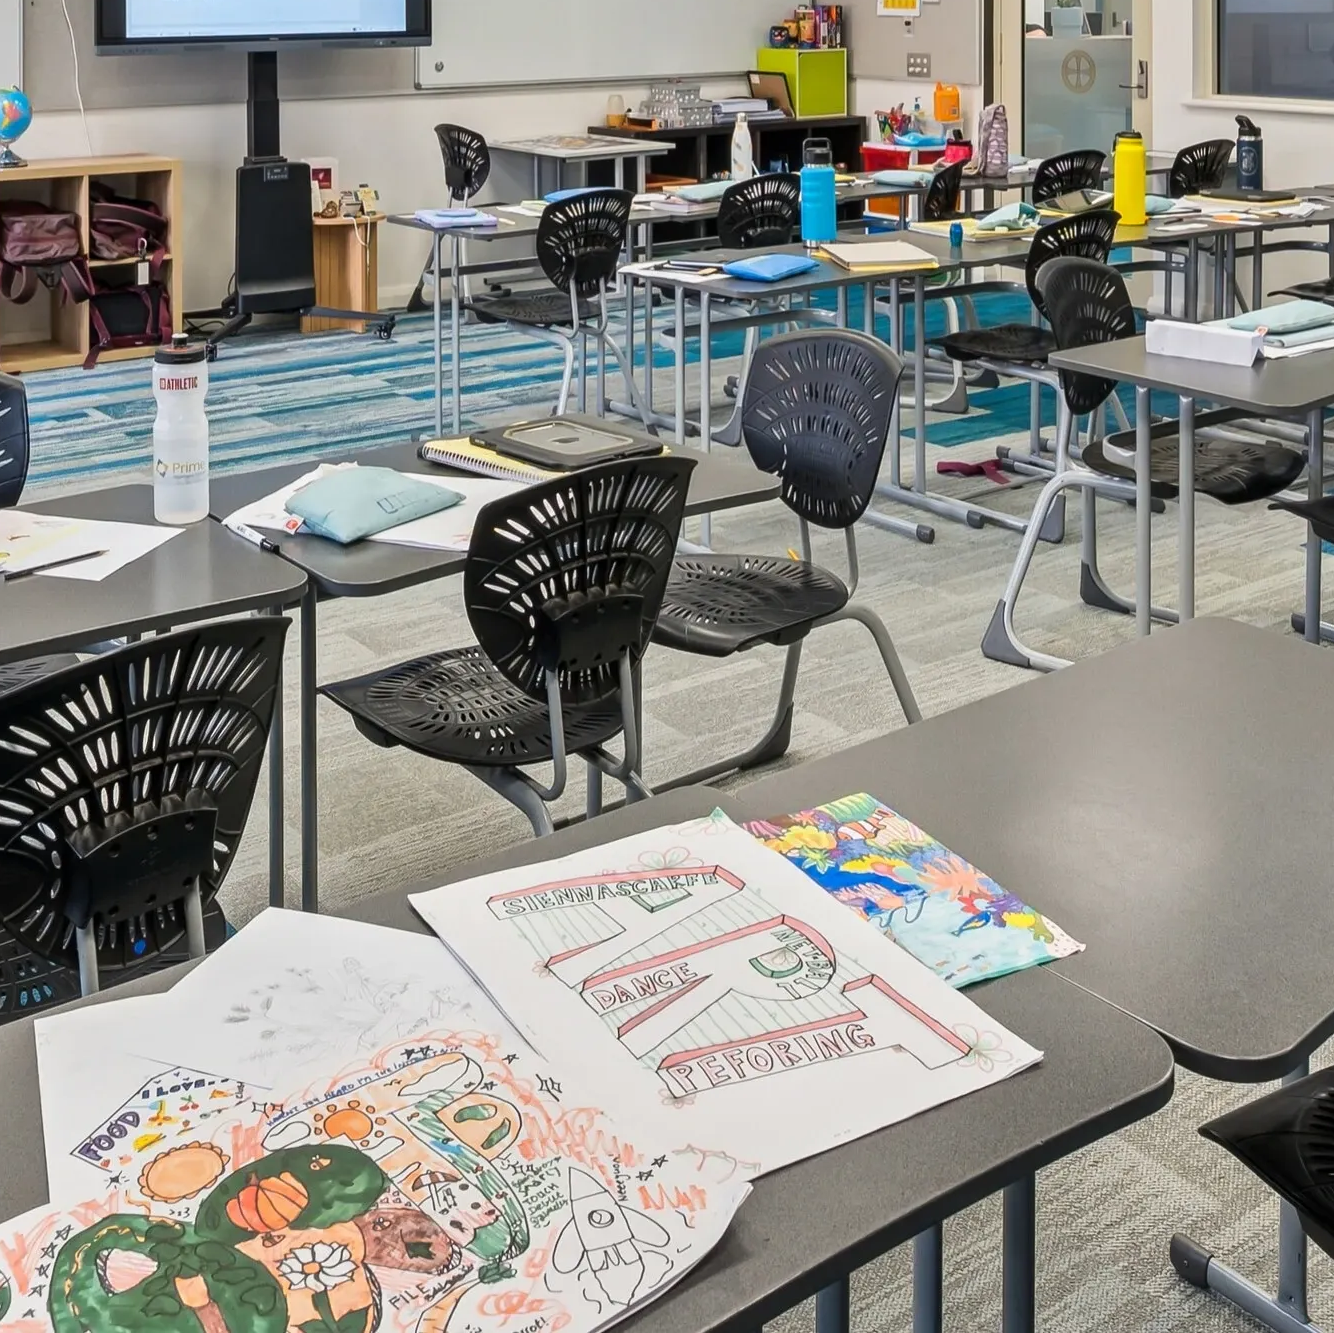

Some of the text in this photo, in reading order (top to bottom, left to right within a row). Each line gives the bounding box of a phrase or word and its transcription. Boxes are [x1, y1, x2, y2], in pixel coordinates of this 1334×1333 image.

[590, 962, 698, 1010] DANCE
[666, 1023, 876, 1094] PEFORING
[77, 1111, 141, 1162] FOOD
[389, 1283, 431, 1310] FILE
